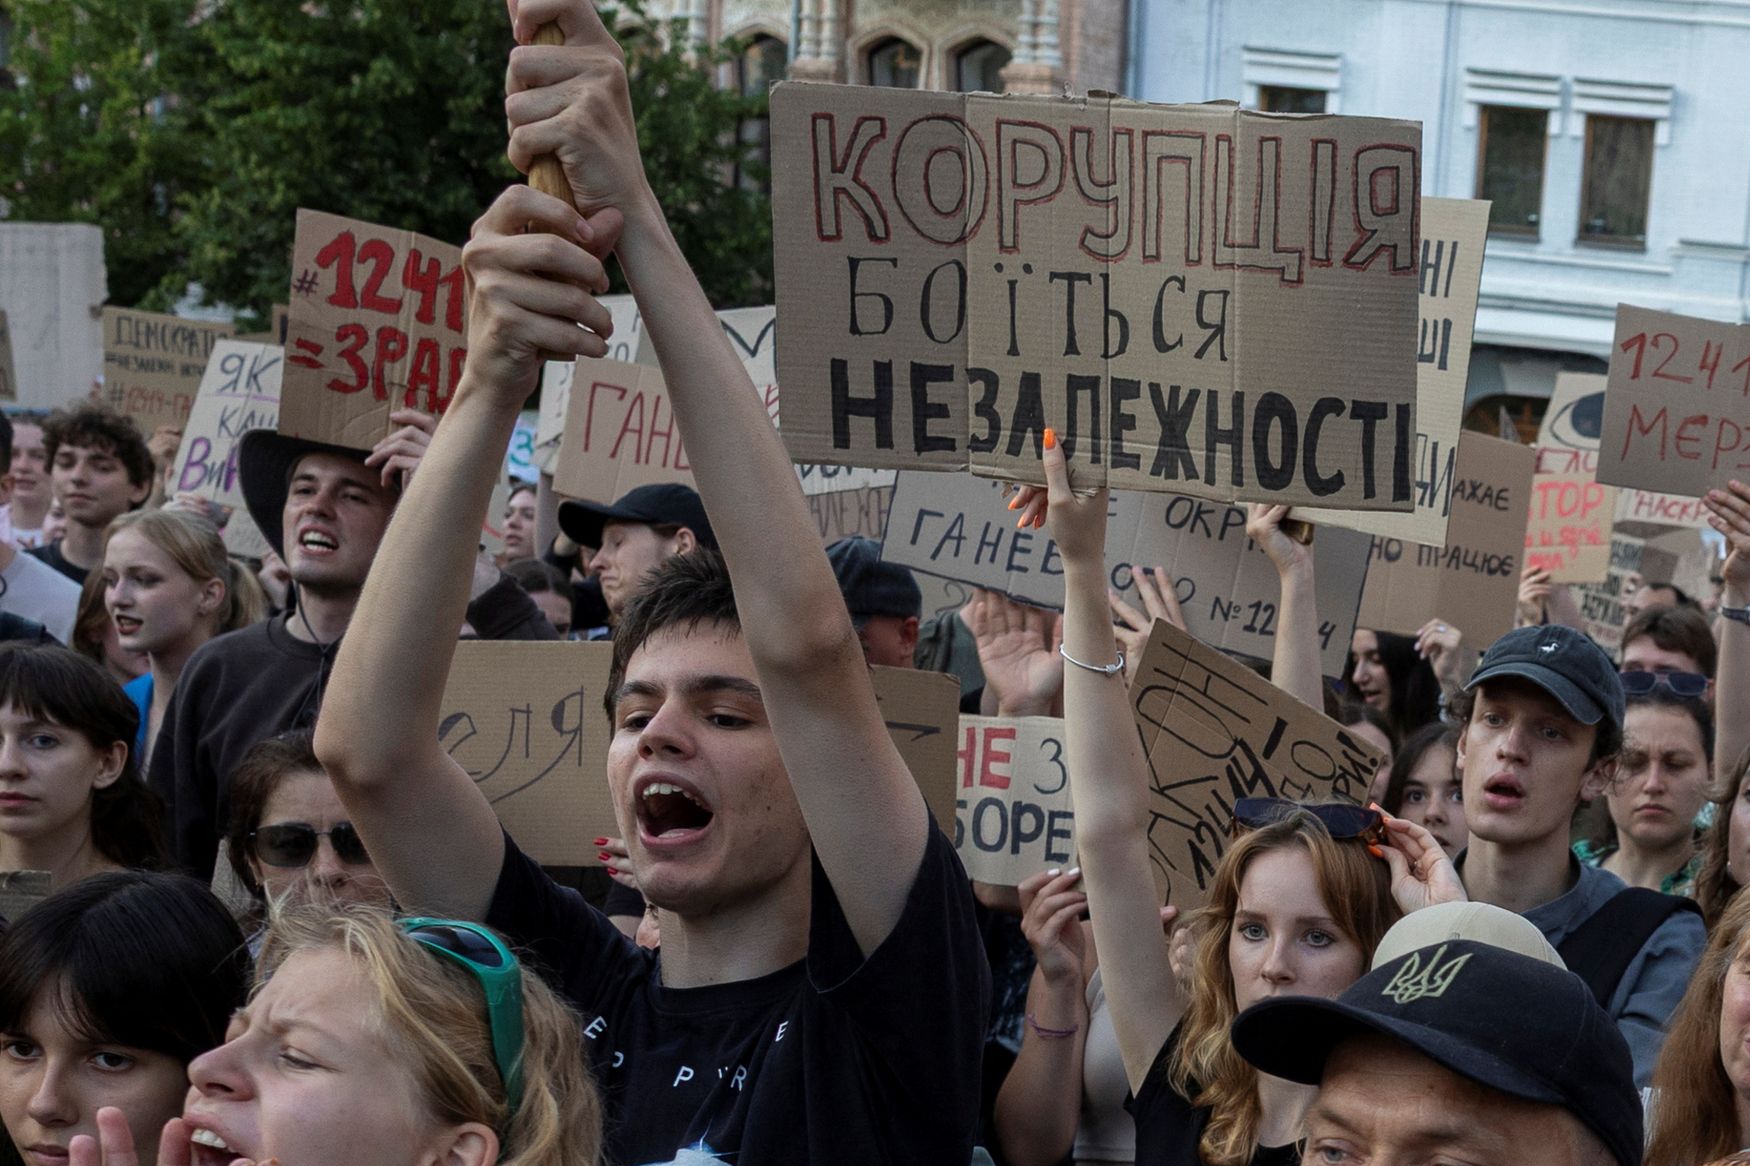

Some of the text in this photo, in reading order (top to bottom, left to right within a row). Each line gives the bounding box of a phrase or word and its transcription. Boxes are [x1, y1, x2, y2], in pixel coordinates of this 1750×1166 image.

[810, 112, 1422, 287] КОРУПЦІЯ
[293, 228, 466, 334] #1241
[847, 256, 1231, 362] БОЇТЬСЯ
[215, 353, 280, 393] ЯК
[829, 356, 1414, 503] НЕЗАЛЕЖНОСТІ
[1165, 495, 1266, 554] ОКР
[1211, 595, 1337, 650] №124
